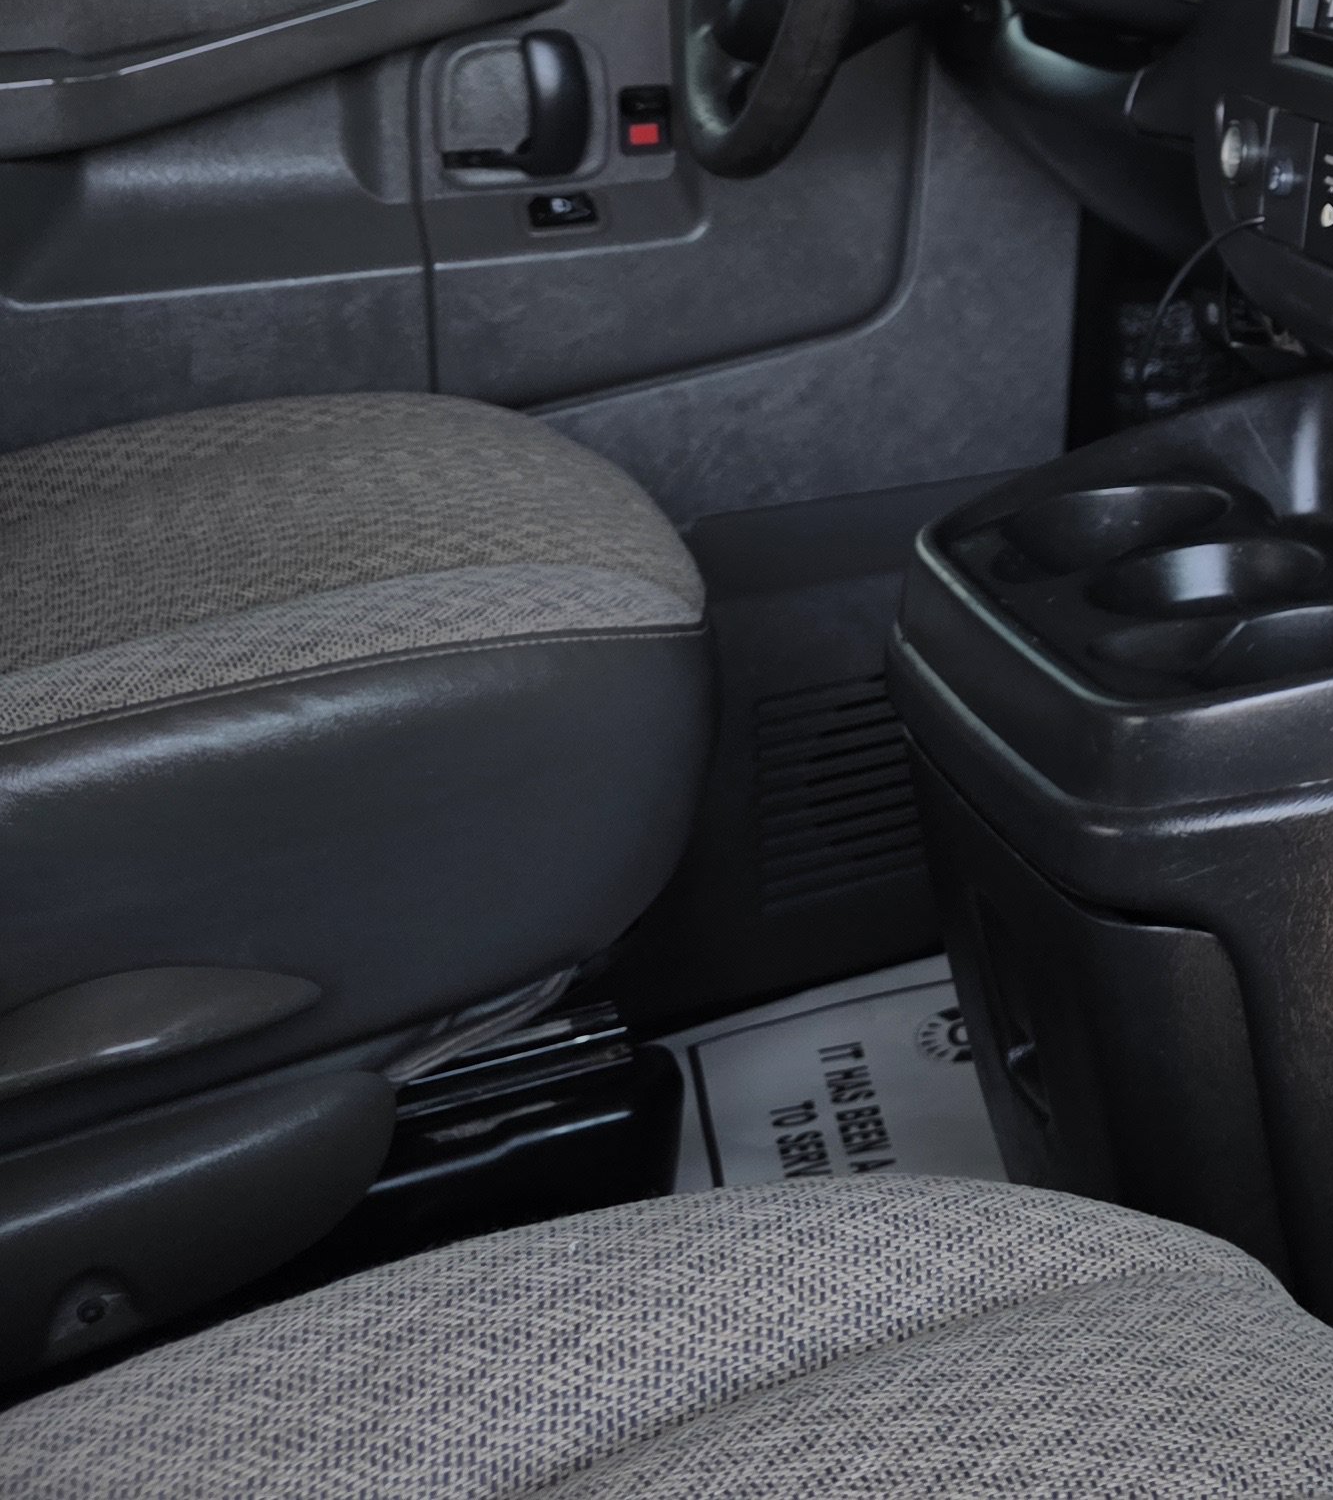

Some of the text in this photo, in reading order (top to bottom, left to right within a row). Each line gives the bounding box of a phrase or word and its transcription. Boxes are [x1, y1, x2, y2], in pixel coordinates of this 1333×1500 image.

[818, 1041, 865, 1063] IT
[824, 1065, 876, 1104] HAS
[769, 1100, 818, 1128] TO
[835, 1104, 891, 1156] BEEN
